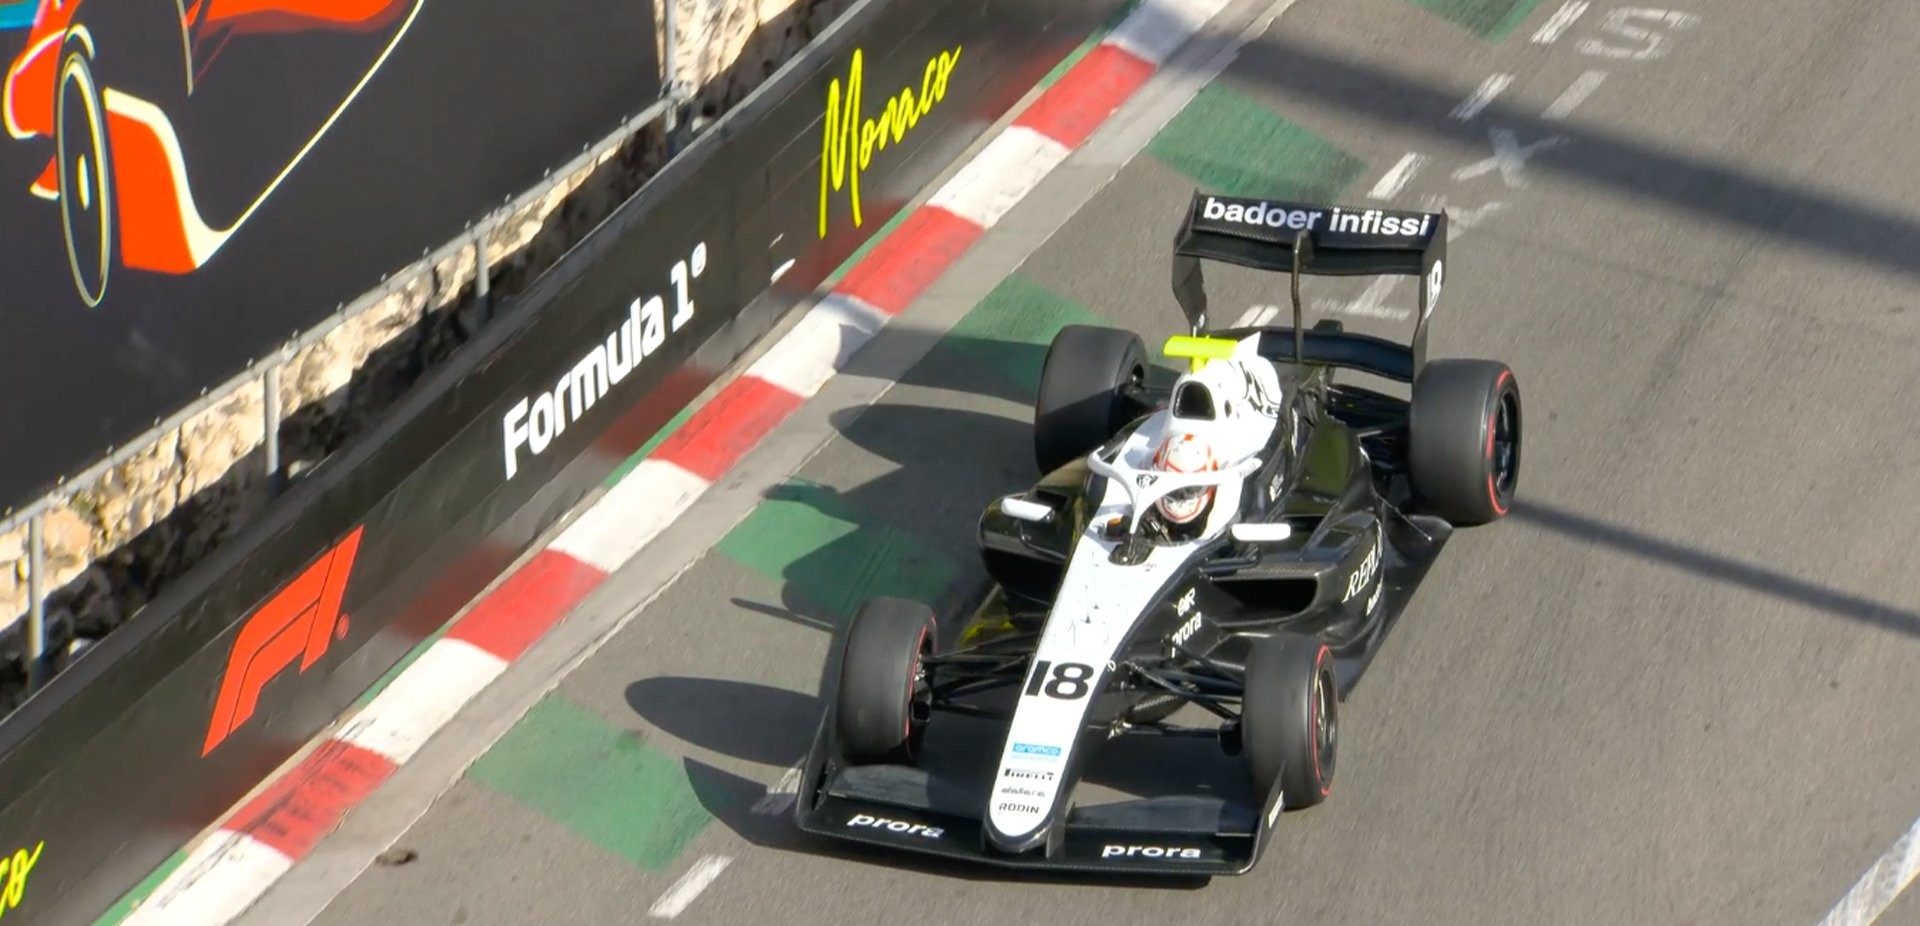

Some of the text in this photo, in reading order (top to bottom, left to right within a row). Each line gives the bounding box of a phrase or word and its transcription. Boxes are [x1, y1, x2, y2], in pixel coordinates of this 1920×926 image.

[819, 46, 962, 239] Monaco
[1203, 197, 1430, 237] badoer infissi
[503, 297, 665, 481] Formula
[1025, 660, 1094, 700] 18
[847, 811, 945, 838] prora
[999, 803, 1040, 813] RODIN
[1101, 842, 1201, 859] prora
